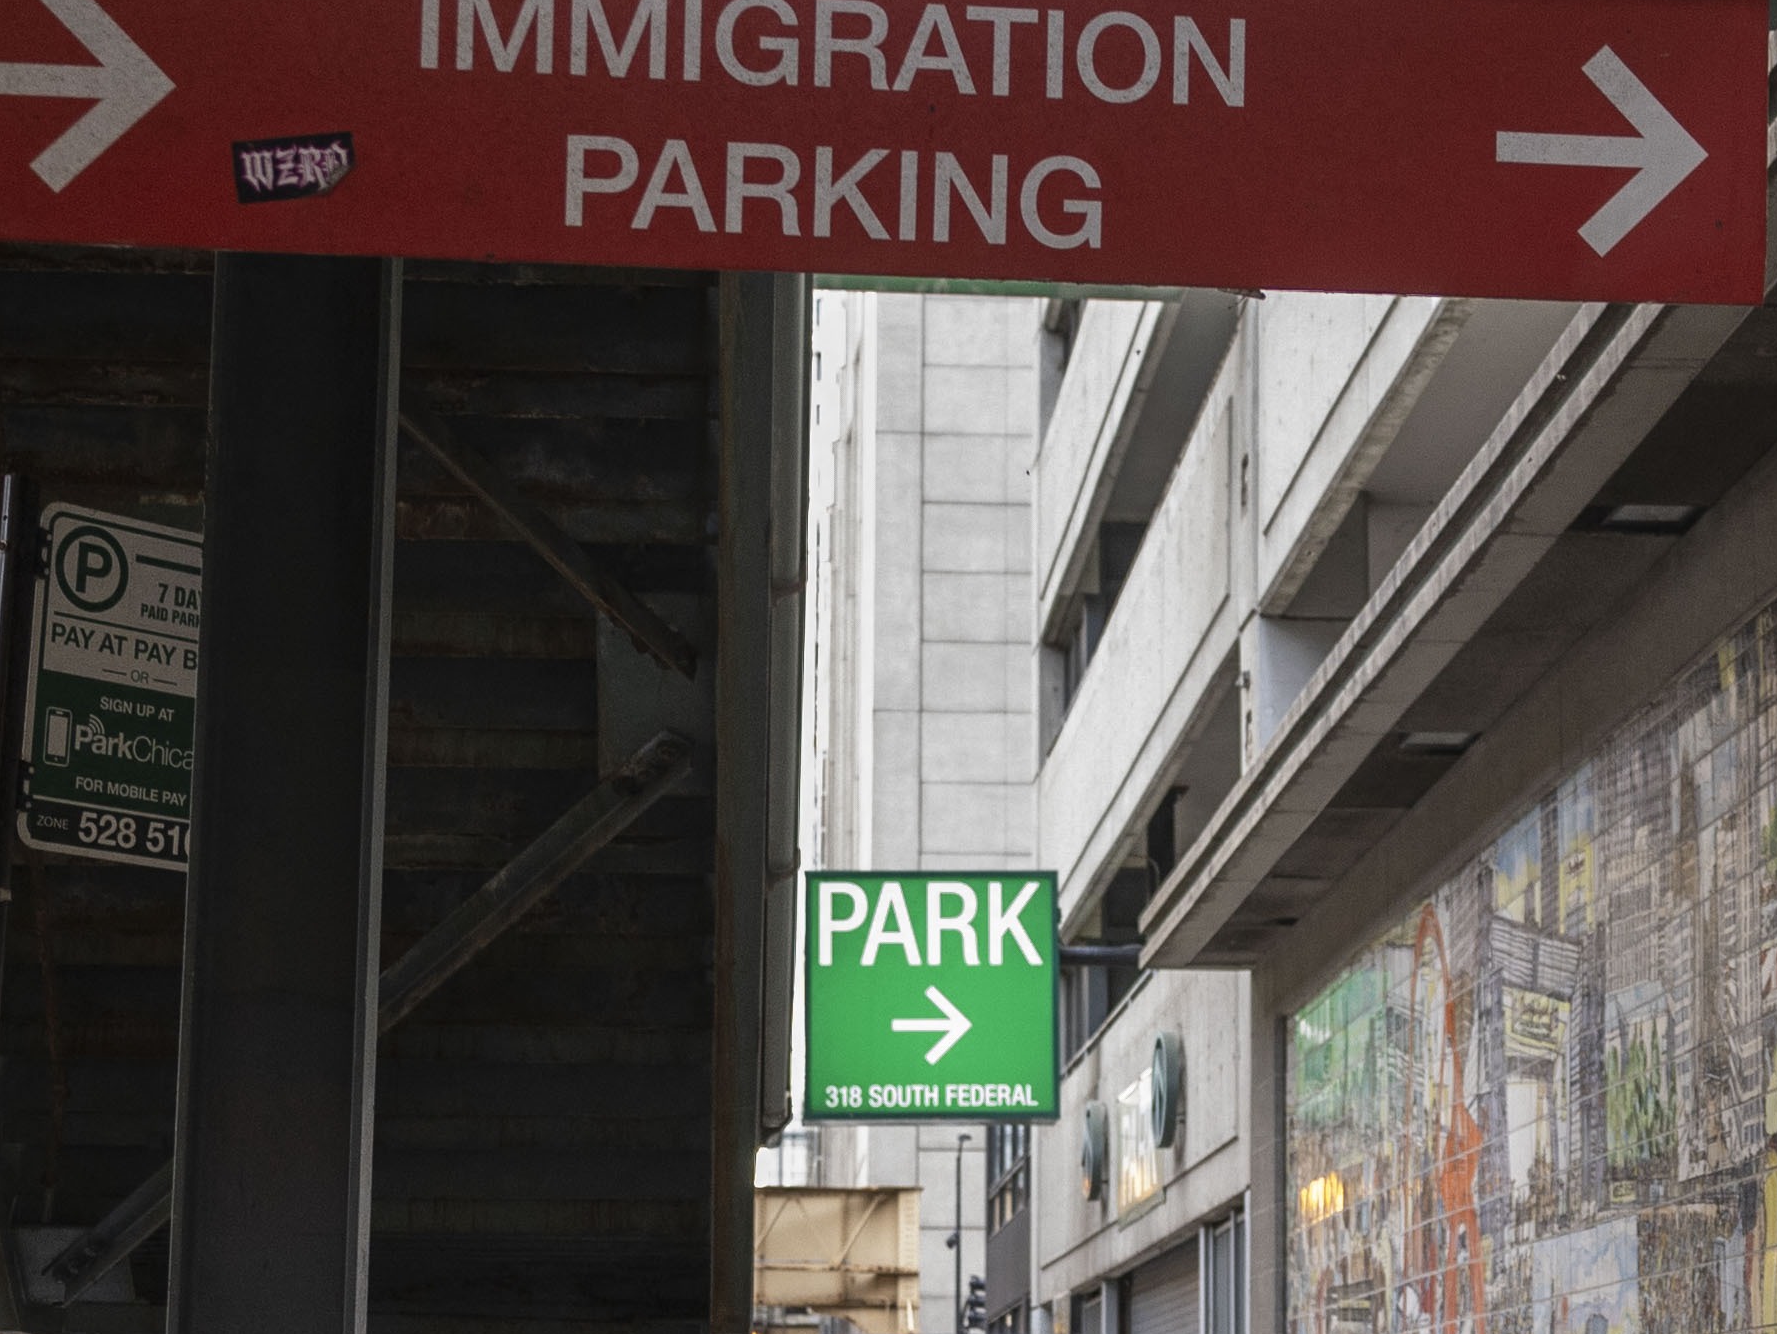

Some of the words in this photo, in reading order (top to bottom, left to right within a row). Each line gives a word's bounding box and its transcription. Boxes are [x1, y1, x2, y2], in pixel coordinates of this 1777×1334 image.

[563, 133, 1105, 251] PARKING
[75, 540, 112, 593] P
[158, 582, 168, 603] 7
[173, 586, 201, 609] DA
[140, 603, 168, 621] PAID
[51, 622, 95, 649] PAY
[98, 633, 127, 656] AT
[133, 638, 176, 665] PAY
[130, 669, 149, 683] OR
[99, 696, 132, 715] SIGN
[136, 704, 155, 719] UP
[158, 708, 174, 722] AT
[75, 776, 104, 794] FOR
[107, 781, 159, 803] MOBILE
[162, 792, 187, 807] PAY
[36, 814, 69, 830] ZONE
[78, 810, 137, 850] 528
[818, 881, 1044, 967] PARK
[825, 1085, 863, 1108] 318
[868, 1084, 939, 1108] SOUTH
[945, 1084, 1039, 1107] FEDERAL
